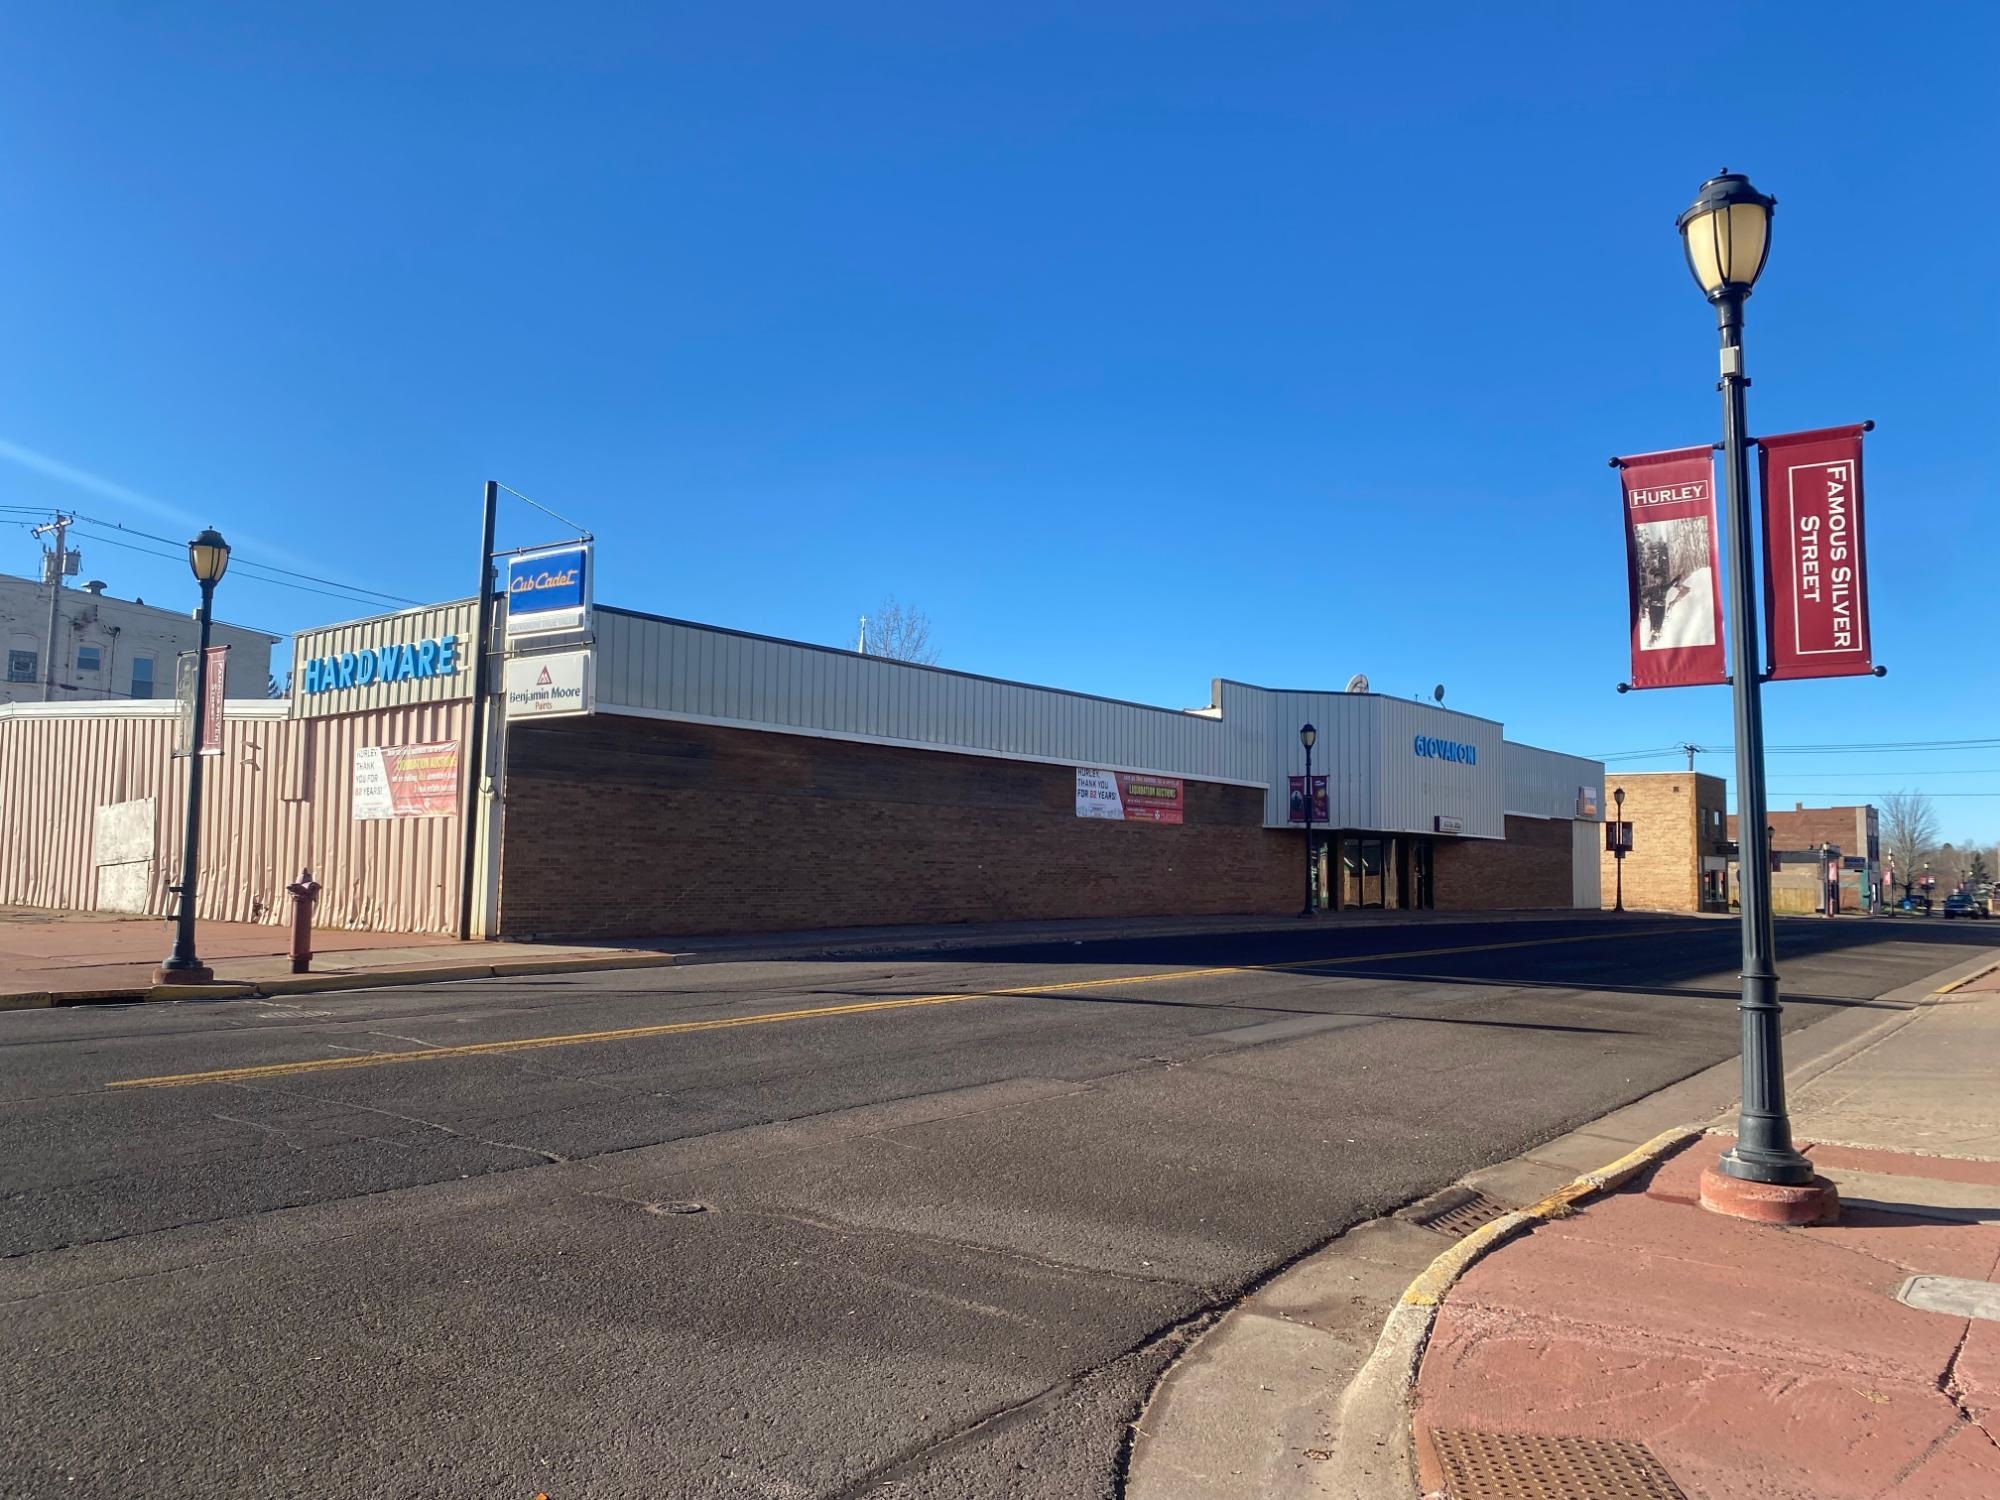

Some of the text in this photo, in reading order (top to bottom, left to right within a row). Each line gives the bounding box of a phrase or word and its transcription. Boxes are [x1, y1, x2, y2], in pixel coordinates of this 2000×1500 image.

[1633, 484, 1704, 505] HURLEY
[1801, 515, 1821, 602] STREET
[1827, 465, 1851, 648] FAMOUS SILVER
[511, 569, 579, 593] Cub Cadet
[304, 634, 458, 694] HARDWARE
[510, 686, 581, 704] Benjamin Moore
[535, 701, 553, 711] Paints
[356, 761, 375, 771] THANK
[356, 774, 379, 784] YOU FOR
[1078, 778, 1109, 789] THANK YOU
[1078, 789, 1089, 798] FOR
[1098, 791, 1118, 801] YEARS!
